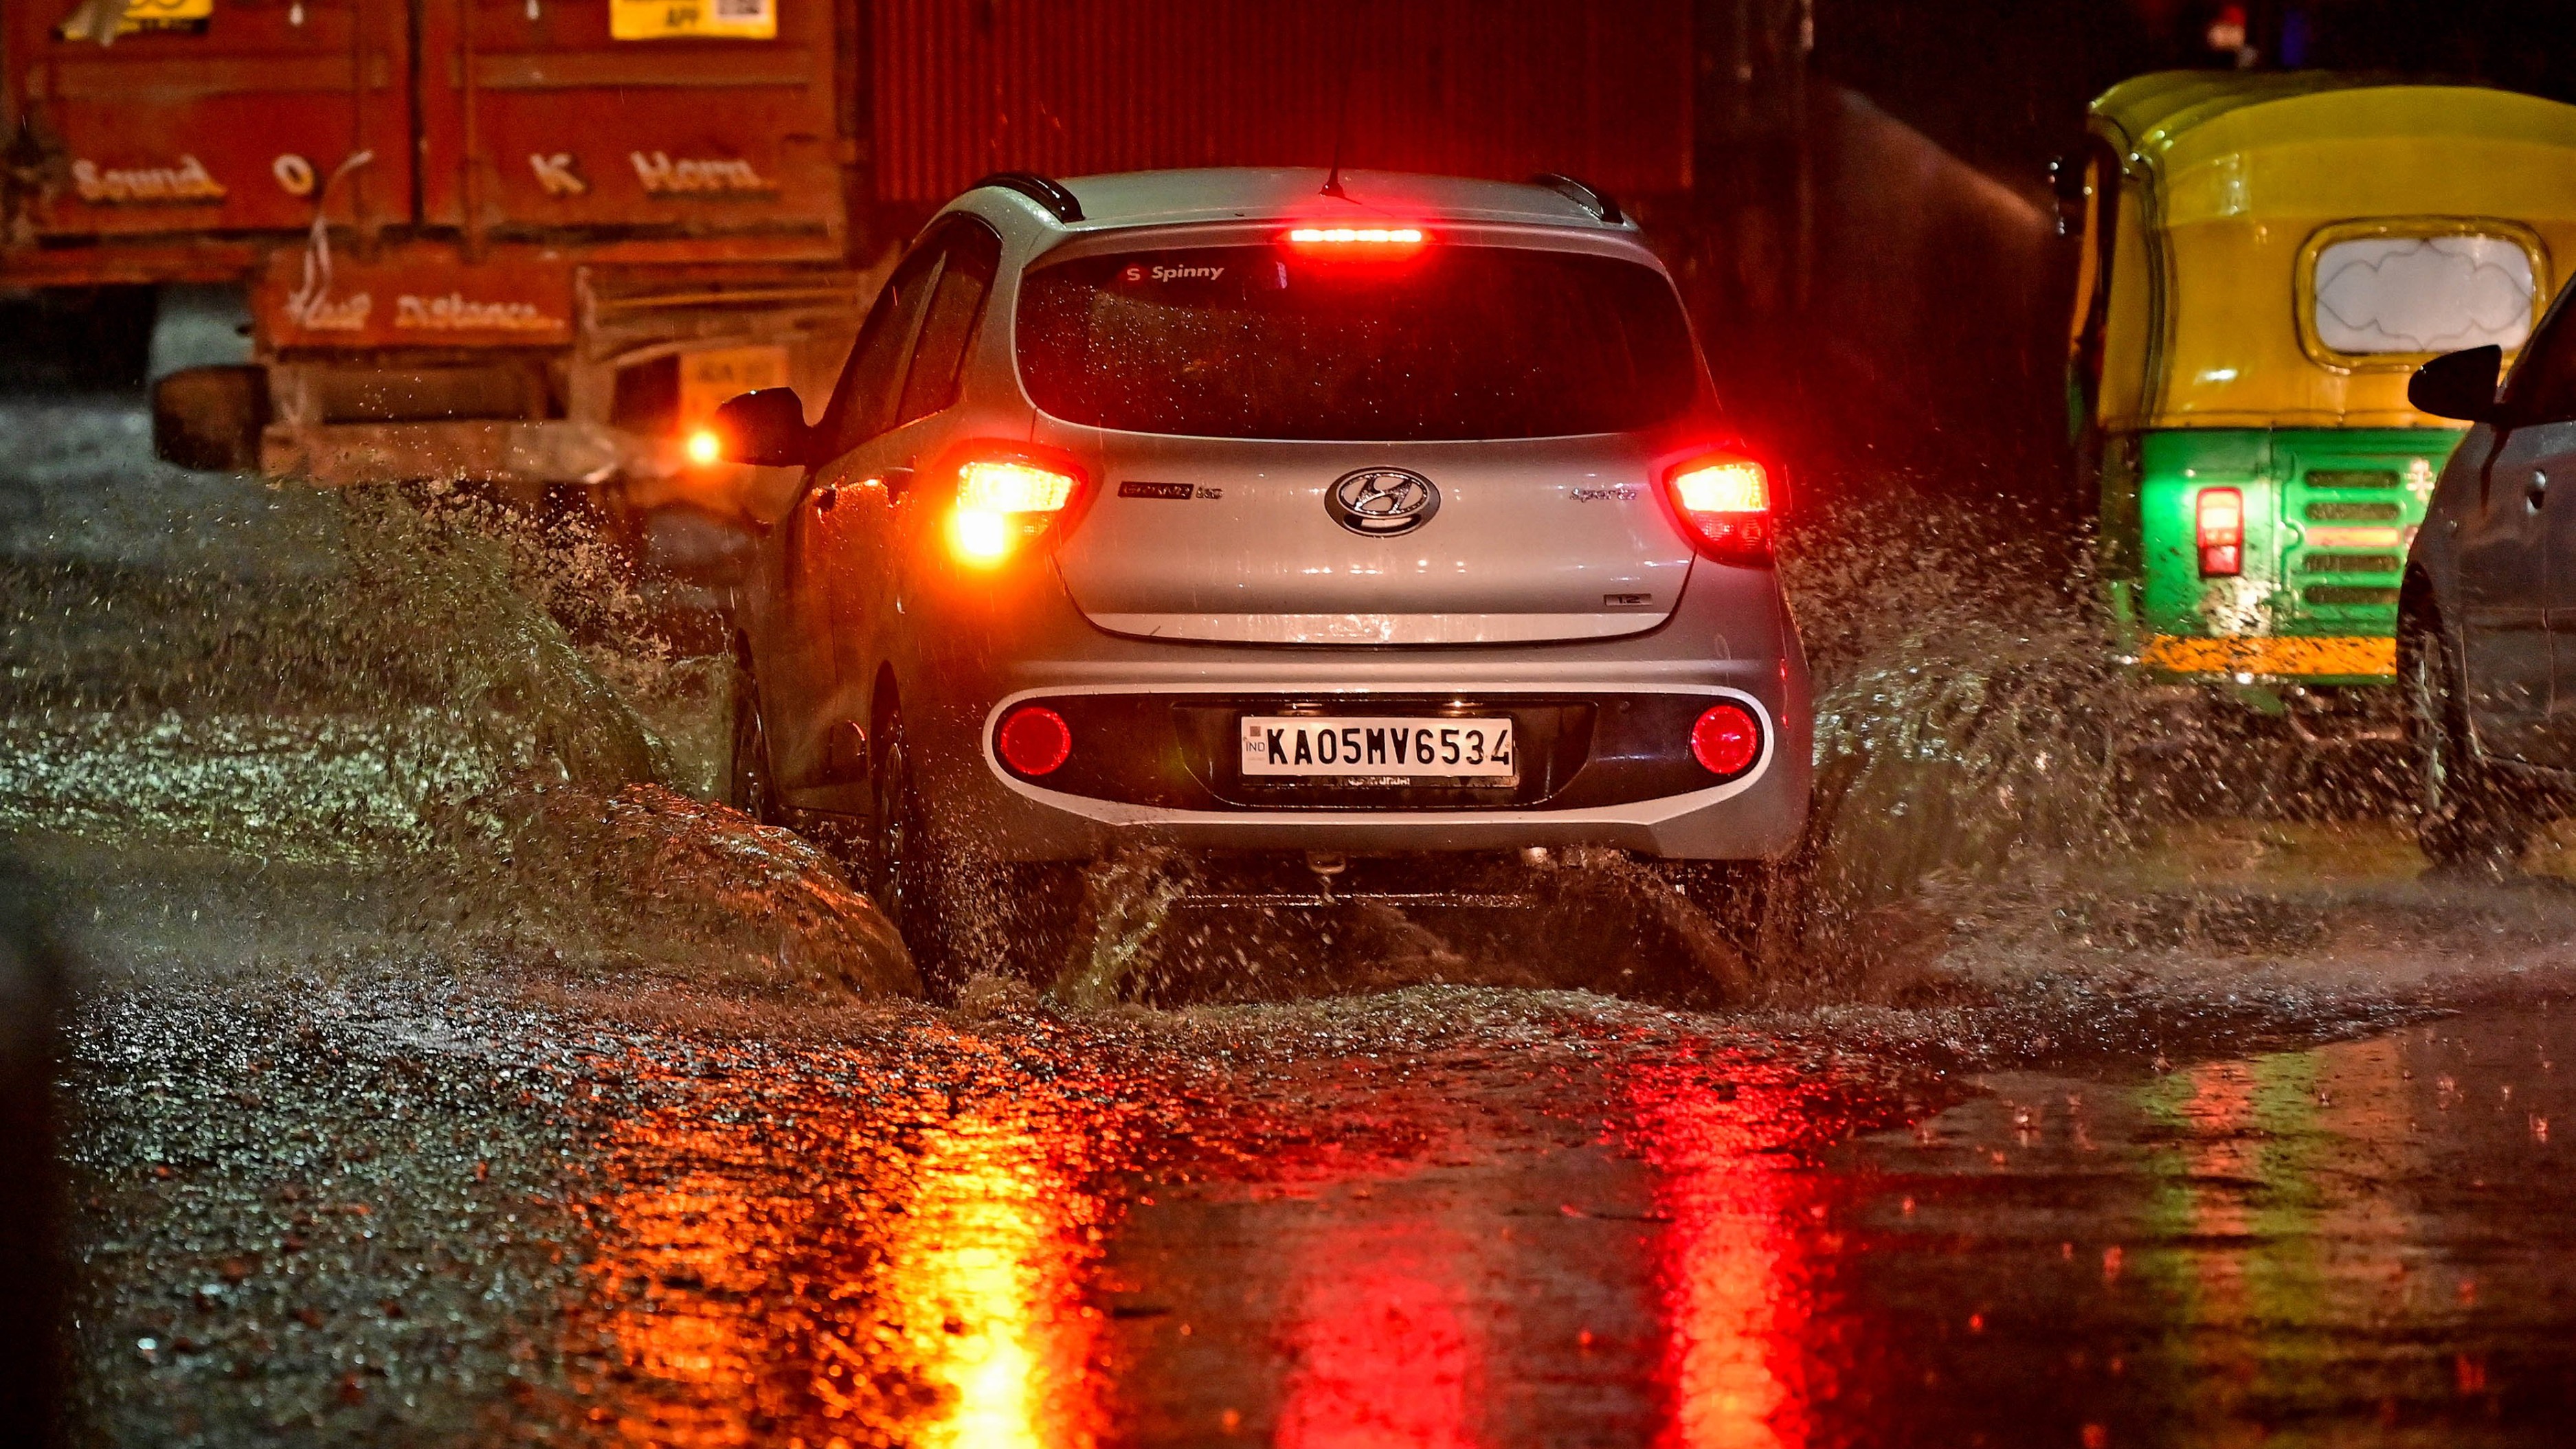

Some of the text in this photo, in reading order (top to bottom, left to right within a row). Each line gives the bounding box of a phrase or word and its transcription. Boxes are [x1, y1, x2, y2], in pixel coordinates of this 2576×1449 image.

[273, 153, 315, 196] O
[530, 153, 586, 194] K
[1127, 264, 1224, 282] S Spinny
[1617, 595, 1641, 604] 1.2
[1246, 741, 1266, 752] IND
[1267, 728, 1510, 766] KA05MV6534
